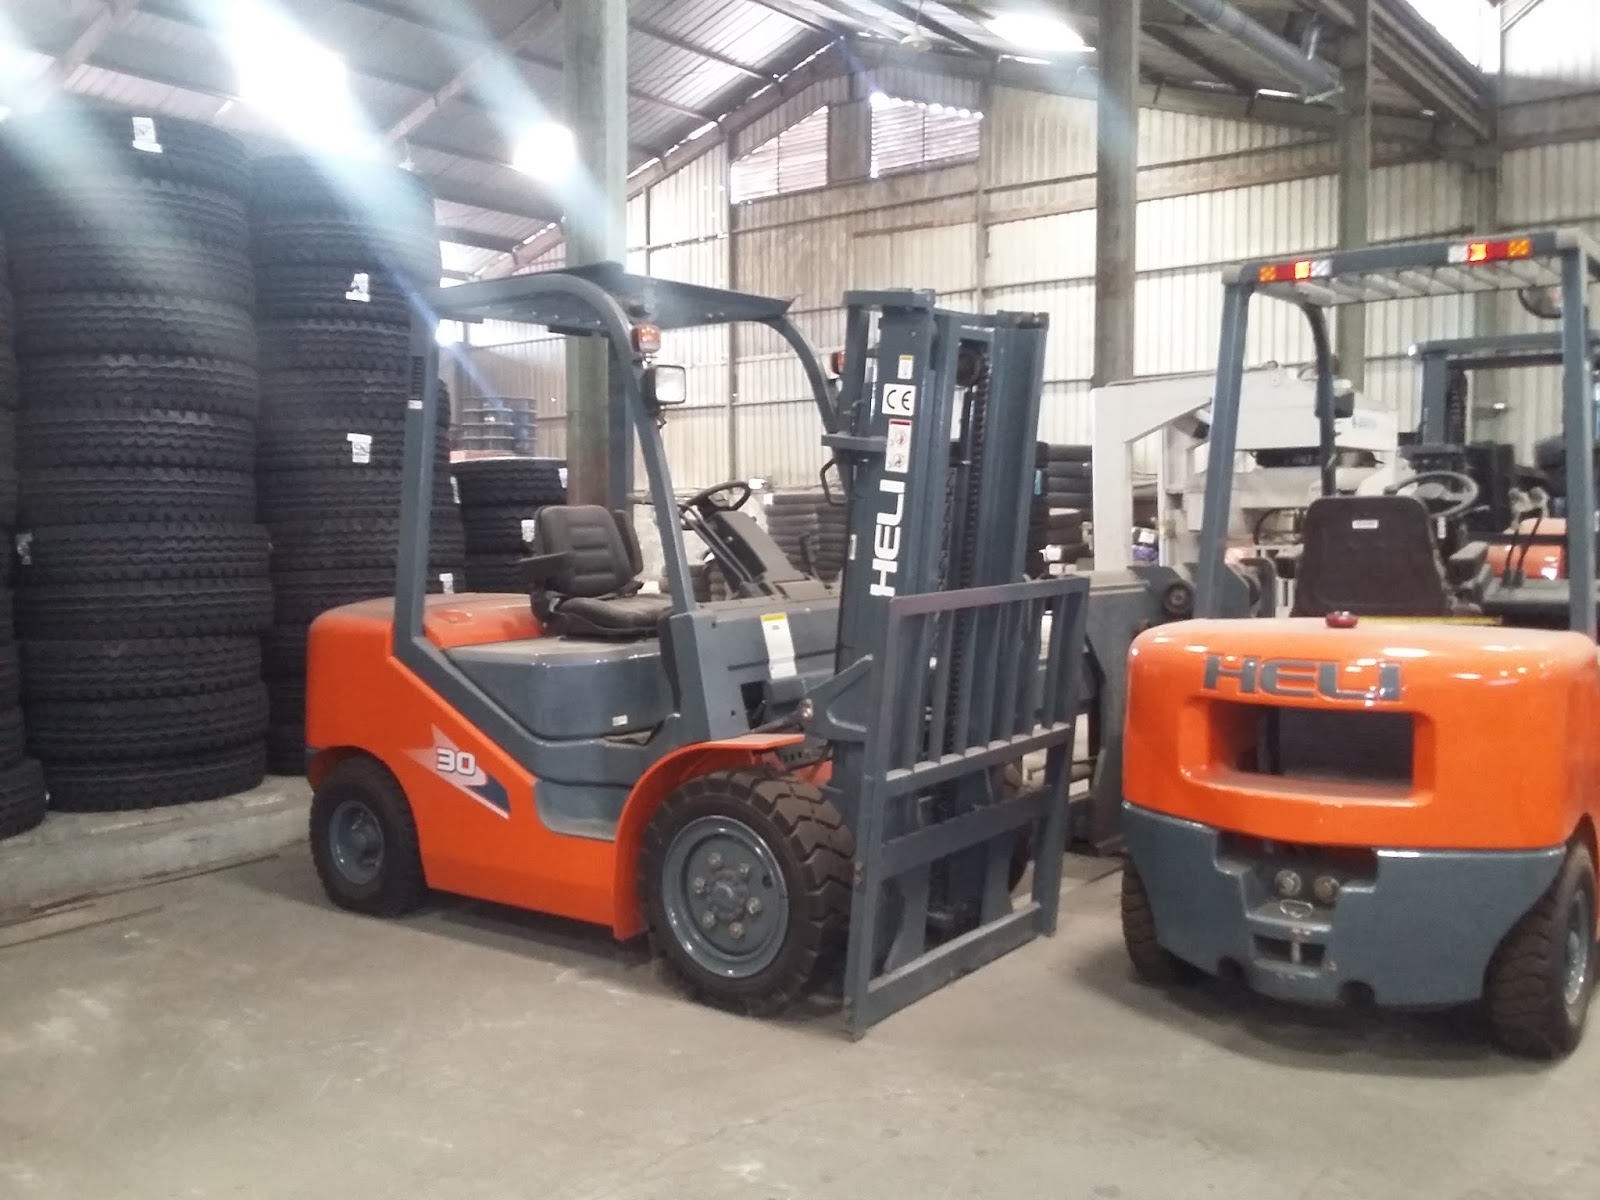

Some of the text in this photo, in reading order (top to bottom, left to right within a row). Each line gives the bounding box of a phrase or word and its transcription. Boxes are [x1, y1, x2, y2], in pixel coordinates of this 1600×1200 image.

[886, 389, 912, 411] CE
[870, 479, 906, 597] HELI
[1203, 655, 1401, 701] HELI
[437, 747, 476, 776] 30
